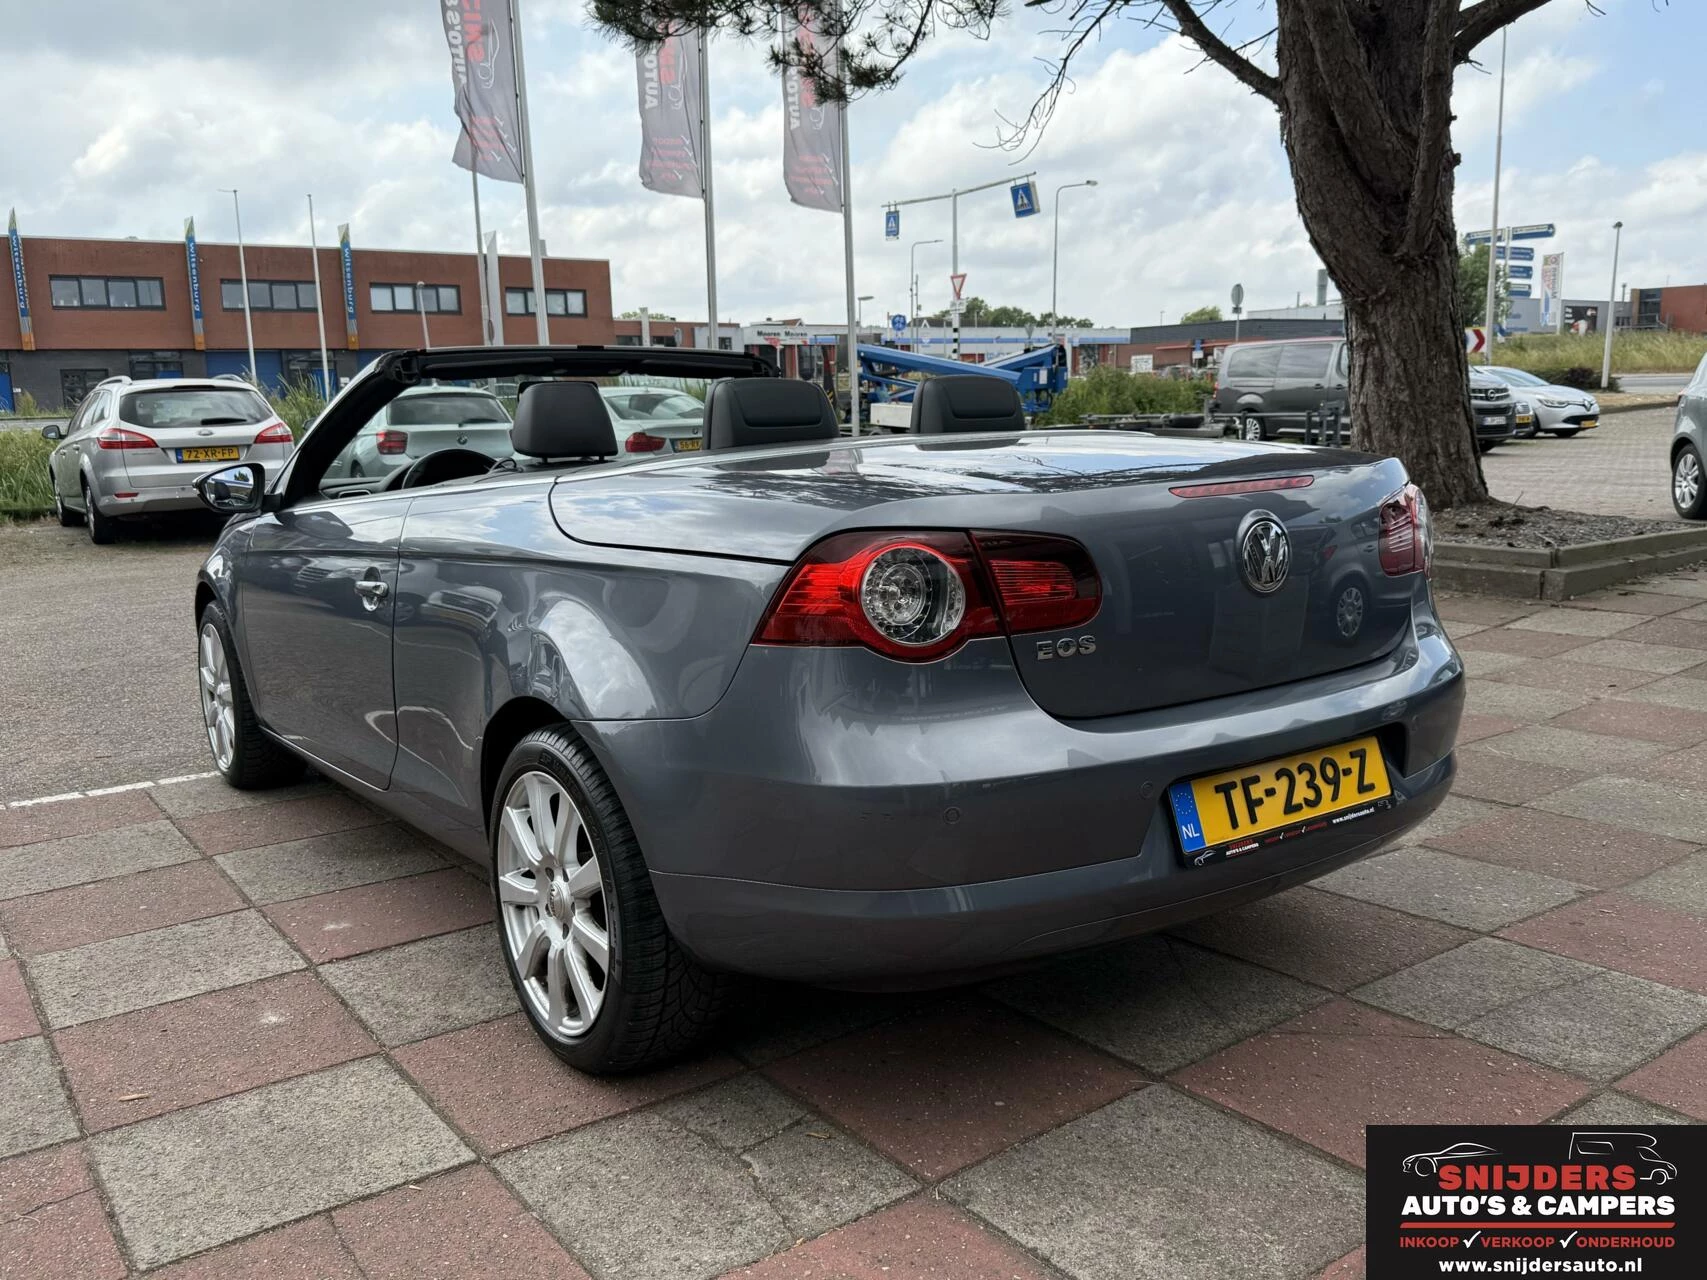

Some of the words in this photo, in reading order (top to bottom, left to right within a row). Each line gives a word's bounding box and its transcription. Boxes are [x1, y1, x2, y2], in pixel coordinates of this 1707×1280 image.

[186, 448, 234, 459] 72-XR-FP
[1036, 635, 1097, 661] EOS
[1214, 748, 1376, 830] TF-239-Z
[1182, 822, 1201, 840] NL
